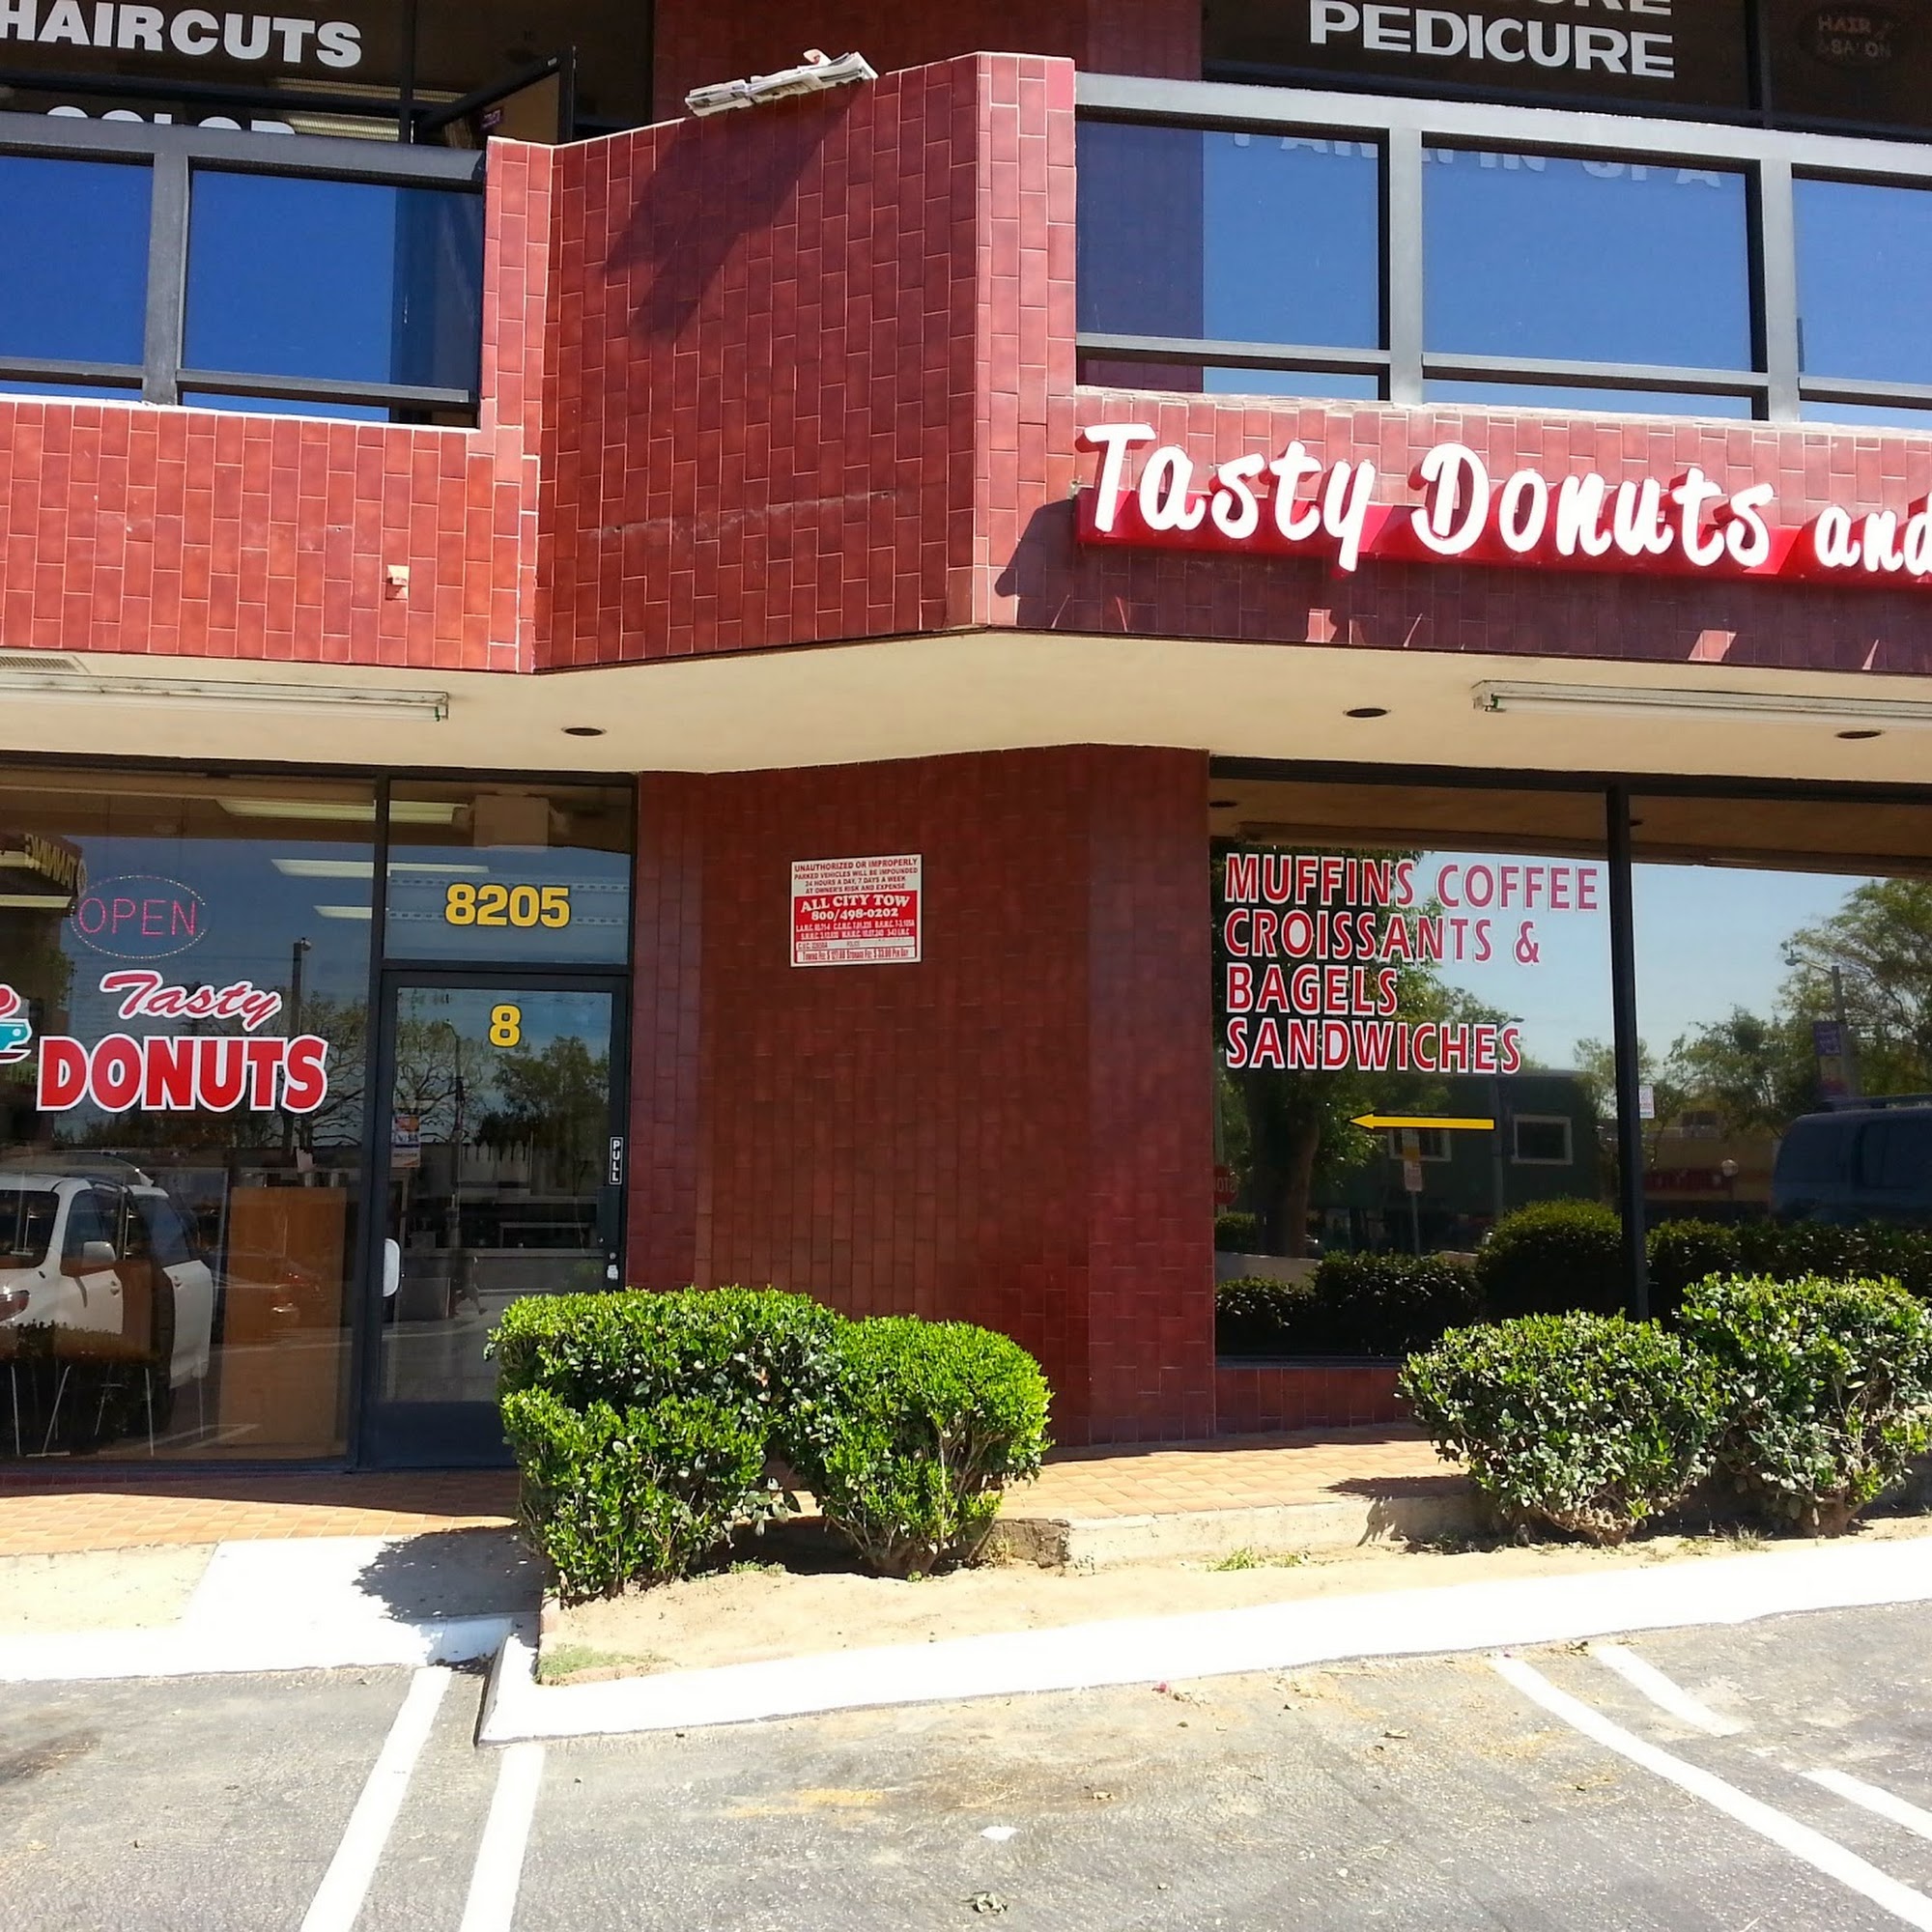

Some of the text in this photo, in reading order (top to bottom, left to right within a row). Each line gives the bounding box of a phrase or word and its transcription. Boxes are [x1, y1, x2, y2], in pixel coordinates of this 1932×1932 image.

[0, 0, 362, 69] HAIRCUTS
[1310, 0, 1675, 79] PEDICURE
[1831, 38, 1892, 58] SAON
[1084, 422, 1932, 577] Tasty Donuts and
[795, 858, 918, 872] UNAUTHORIZED OR IMPROPERLY
[820, 870, 851, 879] VEHICLES
[879, 867, 918, 875] IMPOUNDED
[843, 884, 860, 893] RISK
[876, 882, 906, 891] EXPENSE
[1224, 852, 1599, 911] MUFFINS COFFEE
[78, 897, 197, 936] OPEN
[444, 882, 571, 928] 8205
[801, 895, 911, 913] ALL CITY TOW
[811, 907, 898, 922] 800/498-0202
[1224, 907, 1541, 964] CROISSANTS &
[99, 969, 282, 1032] Tasty
[1226, 961, 1399, 1016] BAGELS
[489, 1003, 522, 1048] 8
[1226, 1016, 1522, 1074] SANDWICHES
[37, 1034, 328, 1114] DONUTS
[611, 1139, 621, 1182] PULL
